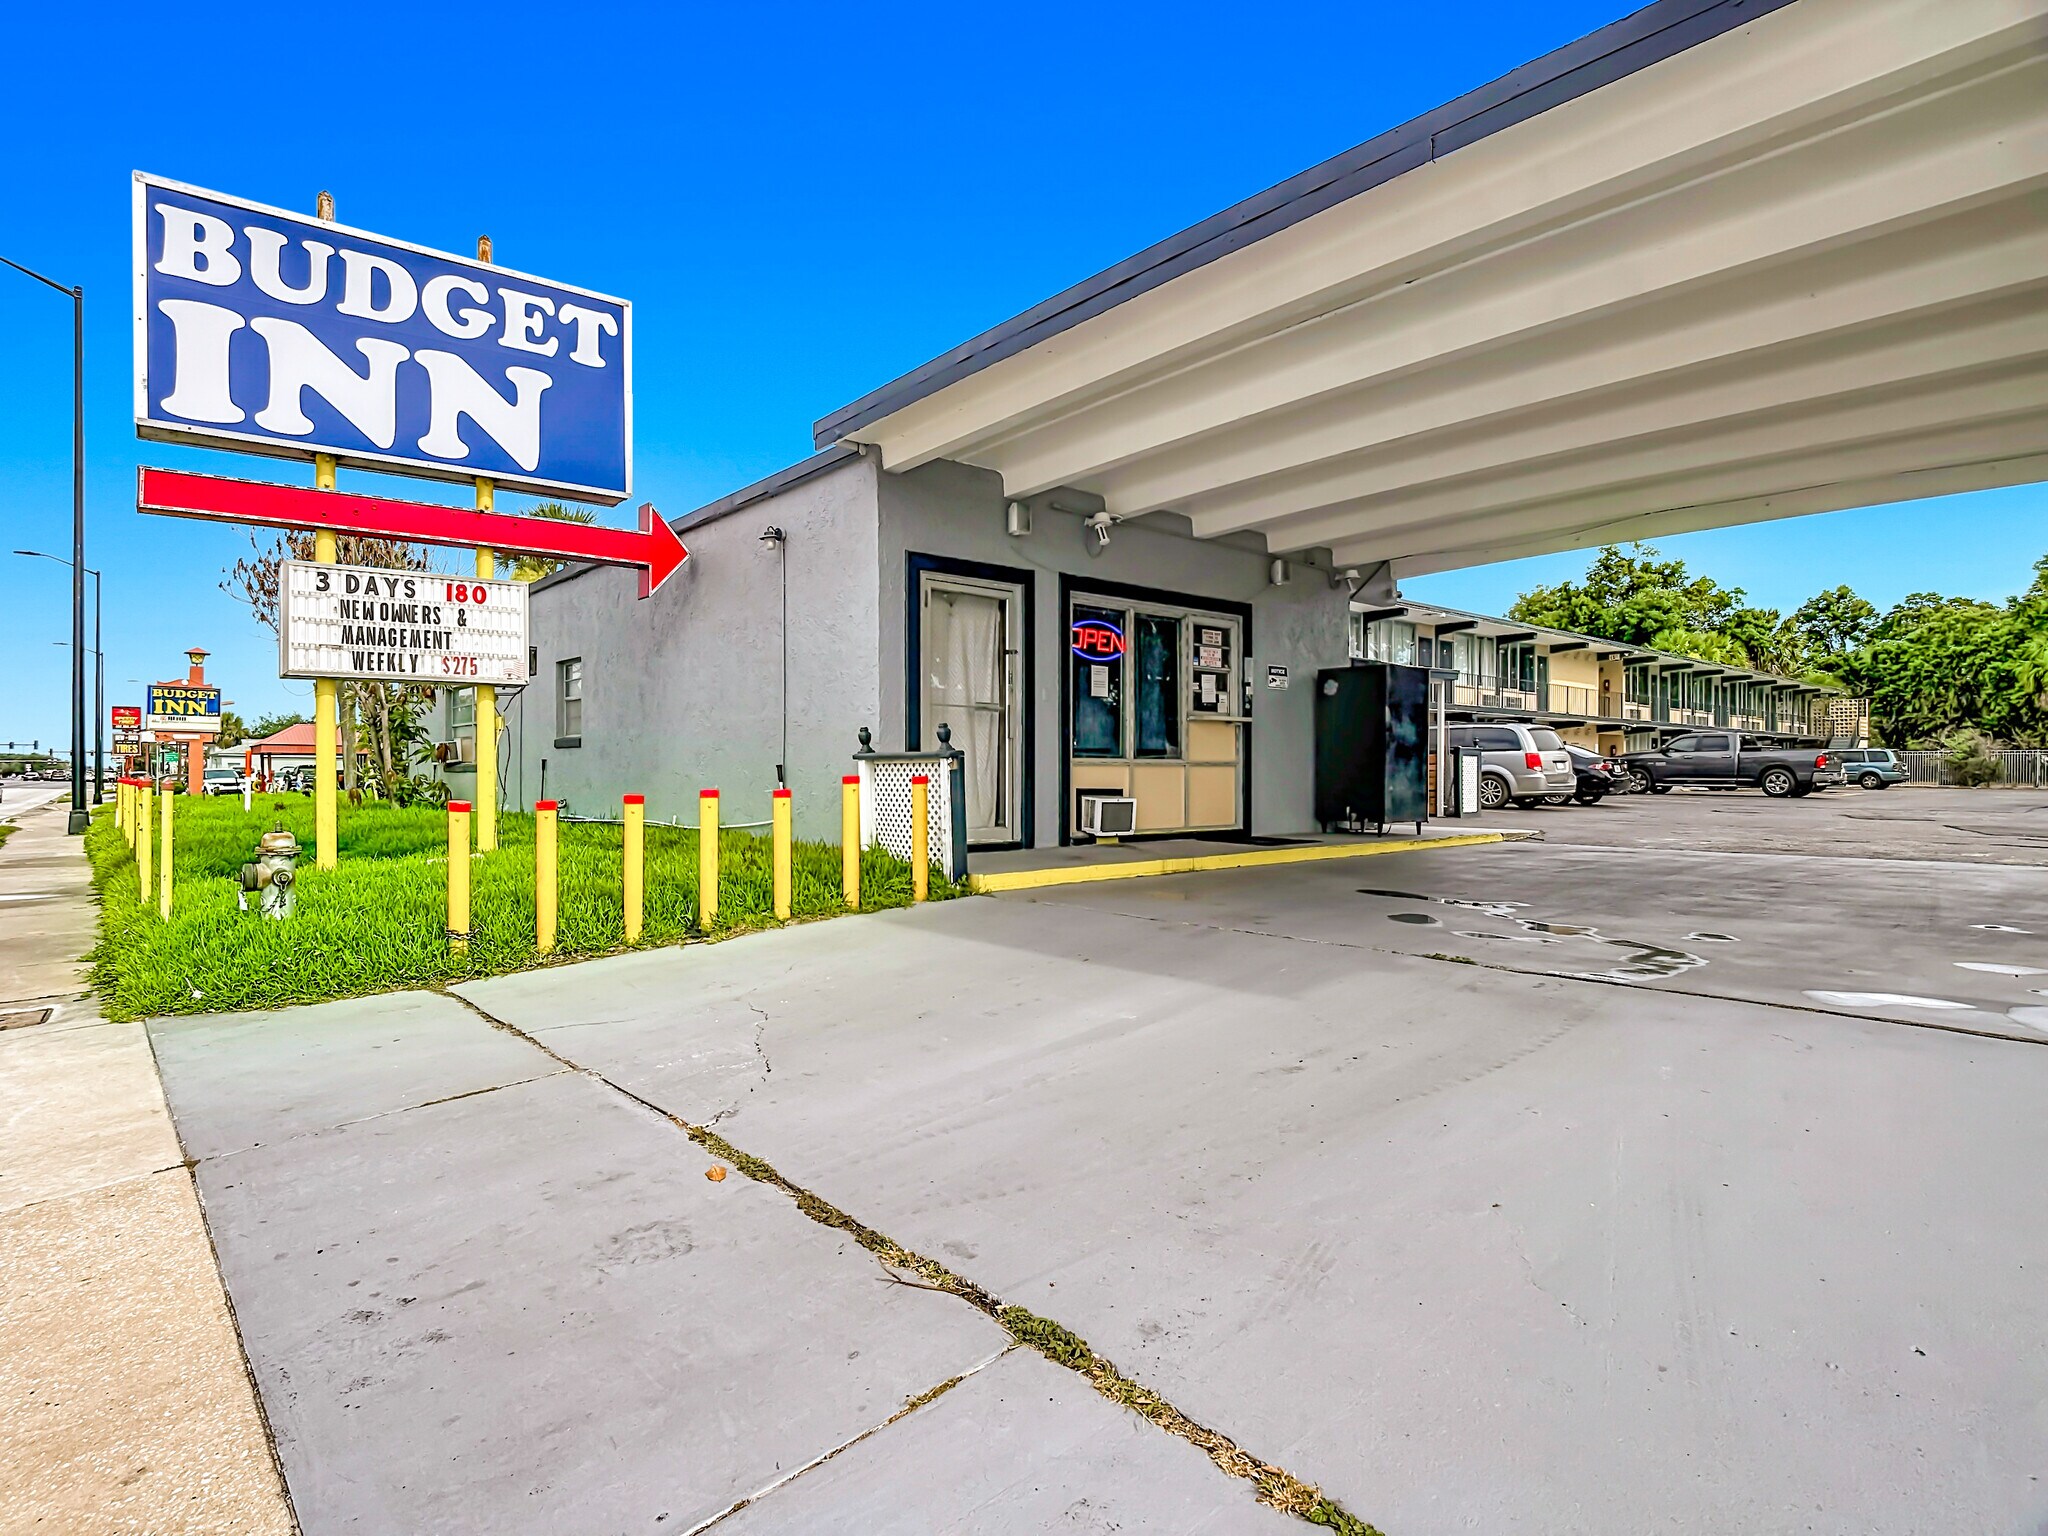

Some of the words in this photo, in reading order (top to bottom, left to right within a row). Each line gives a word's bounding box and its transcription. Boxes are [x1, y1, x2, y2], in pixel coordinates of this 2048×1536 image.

[154, 203, 618, 367] BUDGET
[158, 299, 553, 472] INN
[316, 572, 331, 592] 3
[346, 574, 416, 598] DAYS
[446, 582, 487, 605] 180
[340, 599, 375, 621] NEW
[380, 602, 441, 625] OWNERS
[457, 608, 467, 627] &
[341, 625, 452, 650] MANAGEMENT
[442, 655, 478, 676] $275
[152, 688, 218, 700] BUDGET
[153, 699, 207, 715] INN
[116, 744, 139, 754] TIRES
